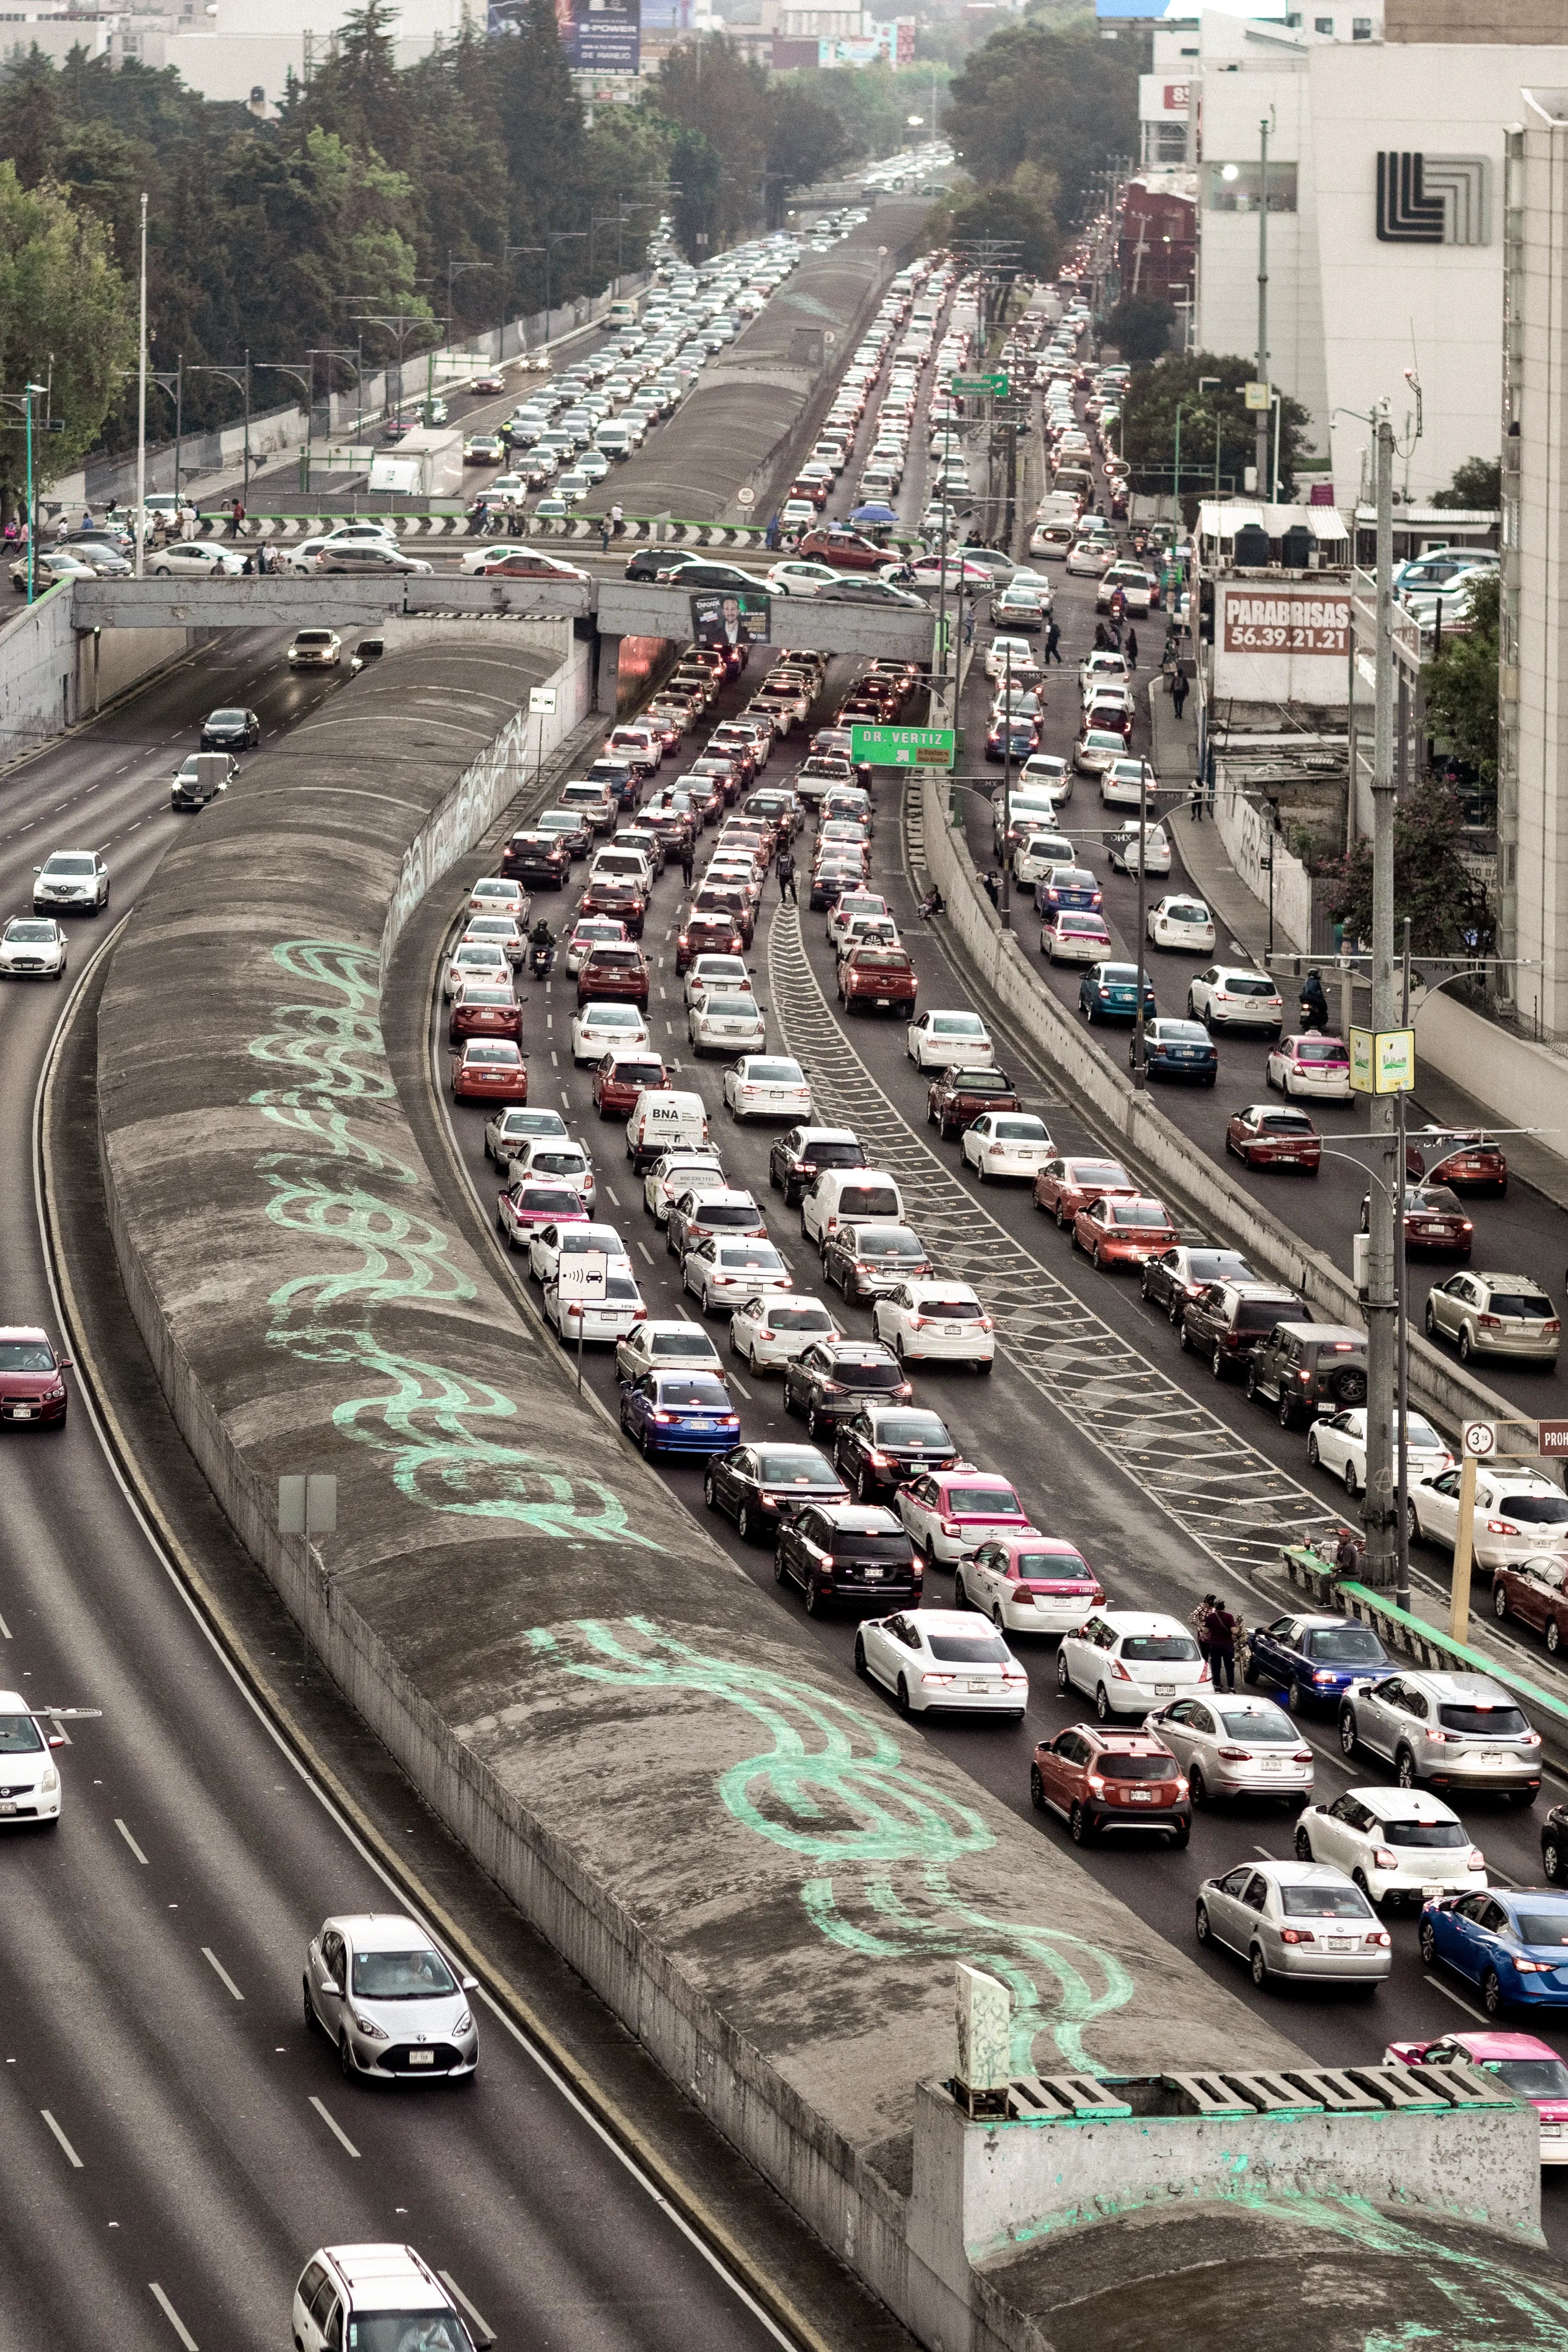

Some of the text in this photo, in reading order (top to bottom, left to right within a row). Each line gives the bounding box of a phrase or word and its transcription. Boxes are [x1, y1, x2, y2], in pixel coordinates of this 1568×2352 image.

[1227, 600, 1348, 628] PARABRISAS
[1230, 627, 1344, 649] 56.39.21.21
[863, 731, 942, 744] DR. VERTIZ
[653, 1109, 678, 1119] BNA
[1472, 1432, 1480, 1445] 3
